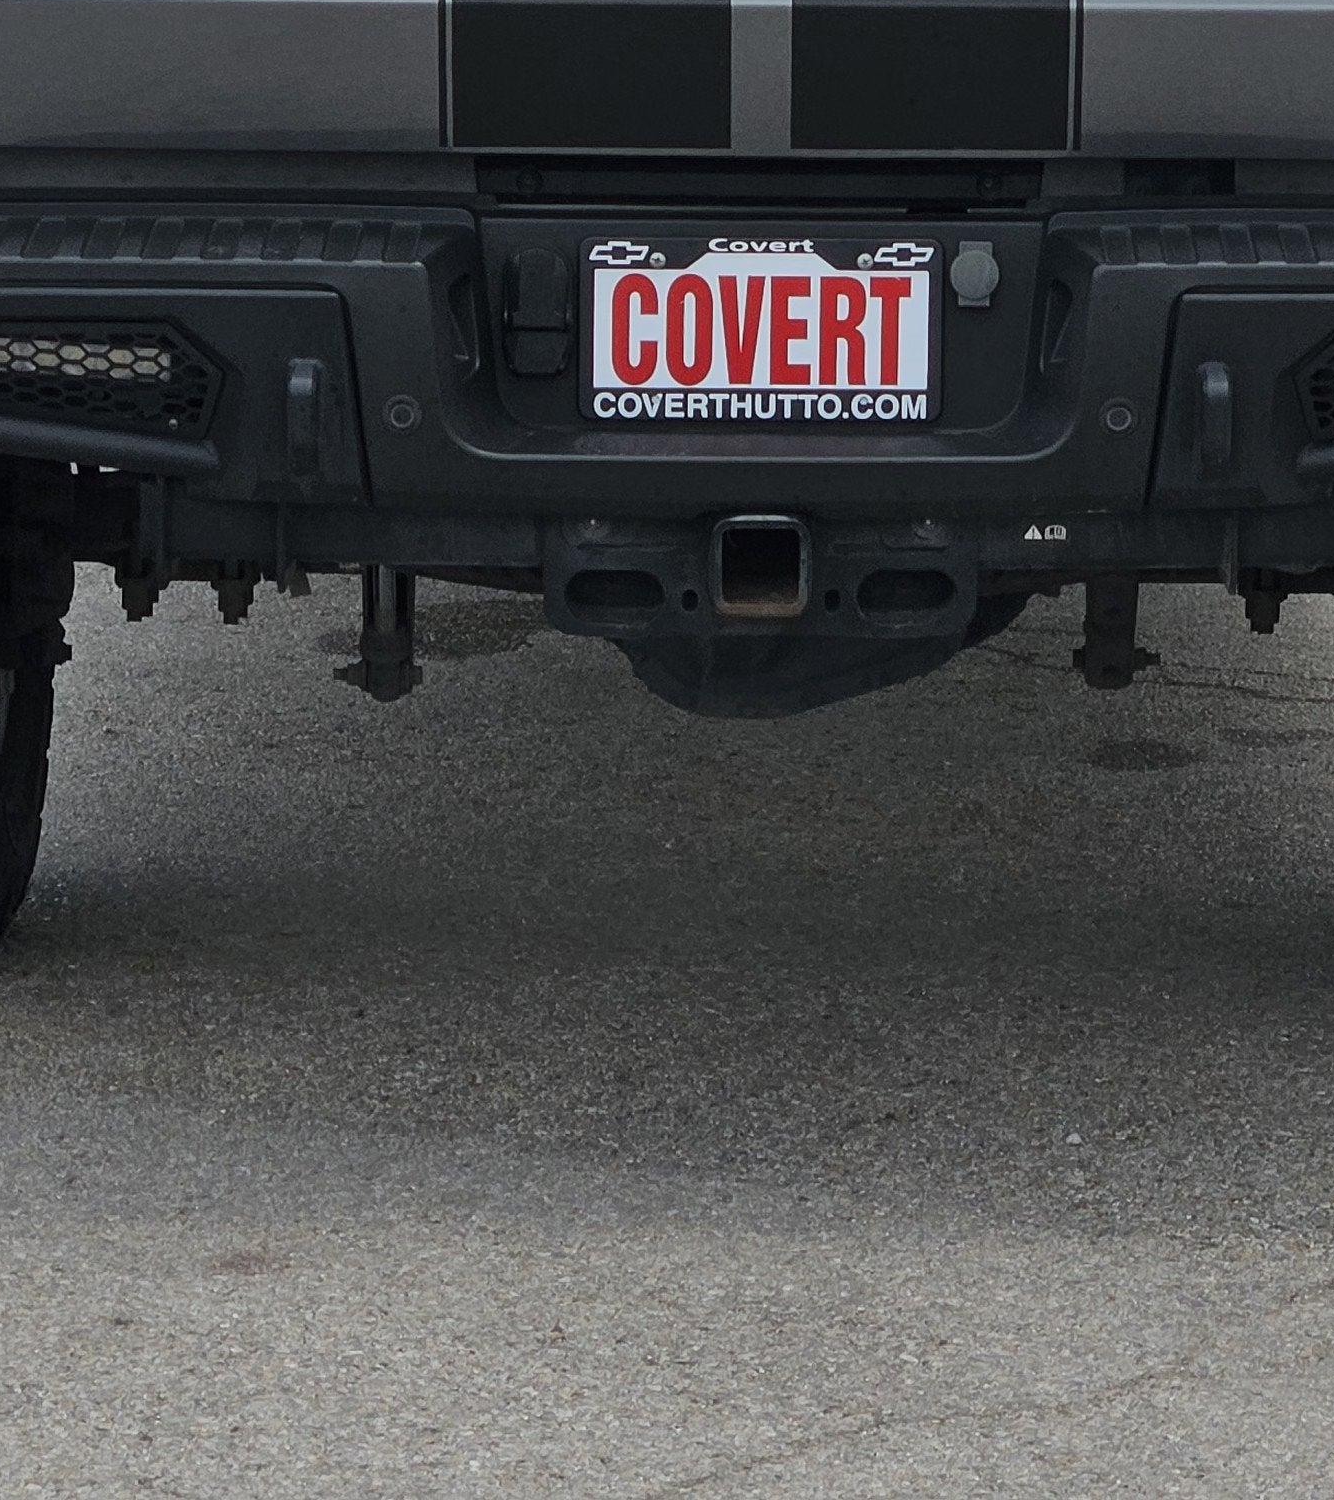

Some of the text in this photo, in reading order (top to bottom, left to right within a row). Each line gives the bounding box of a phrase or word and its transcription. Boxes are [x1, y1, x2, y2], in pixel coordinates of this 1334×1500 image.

[708, 237, 814, 253] Covert
[611, 273, 912, 386] COVERT
[593, 392, 927, 420] COVERTHUTTO.COM
